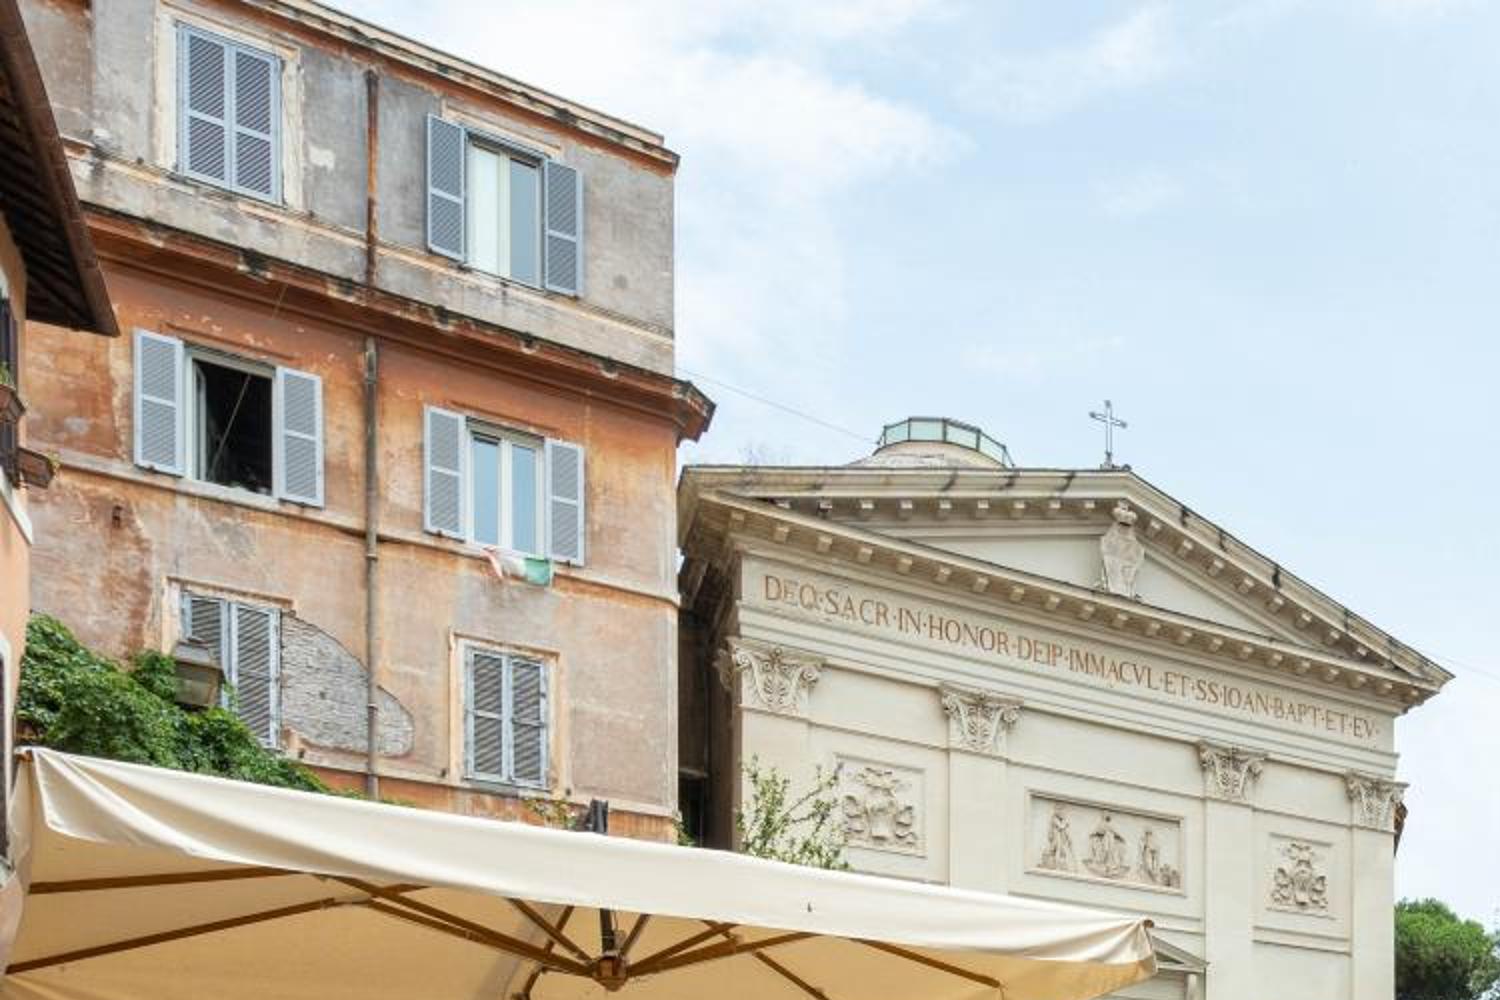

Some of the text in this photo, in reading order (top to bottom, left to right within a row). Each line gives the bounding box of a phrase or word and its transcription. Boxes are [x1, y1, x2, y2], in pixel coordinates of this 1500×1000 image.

[825, 589, 890, 627] SACR
[898, 607, 921, 634] IN
[928, 613, 1009, 656] HONOR
[1017, 635, 1062, 667] DEIP
[1164, 671, 1191, 698] ET
[1223, 685, 1269, 715] IOAN
[1273, 697, 1321, 728] BAPT
[1325, 709, 1348, 733] ET
